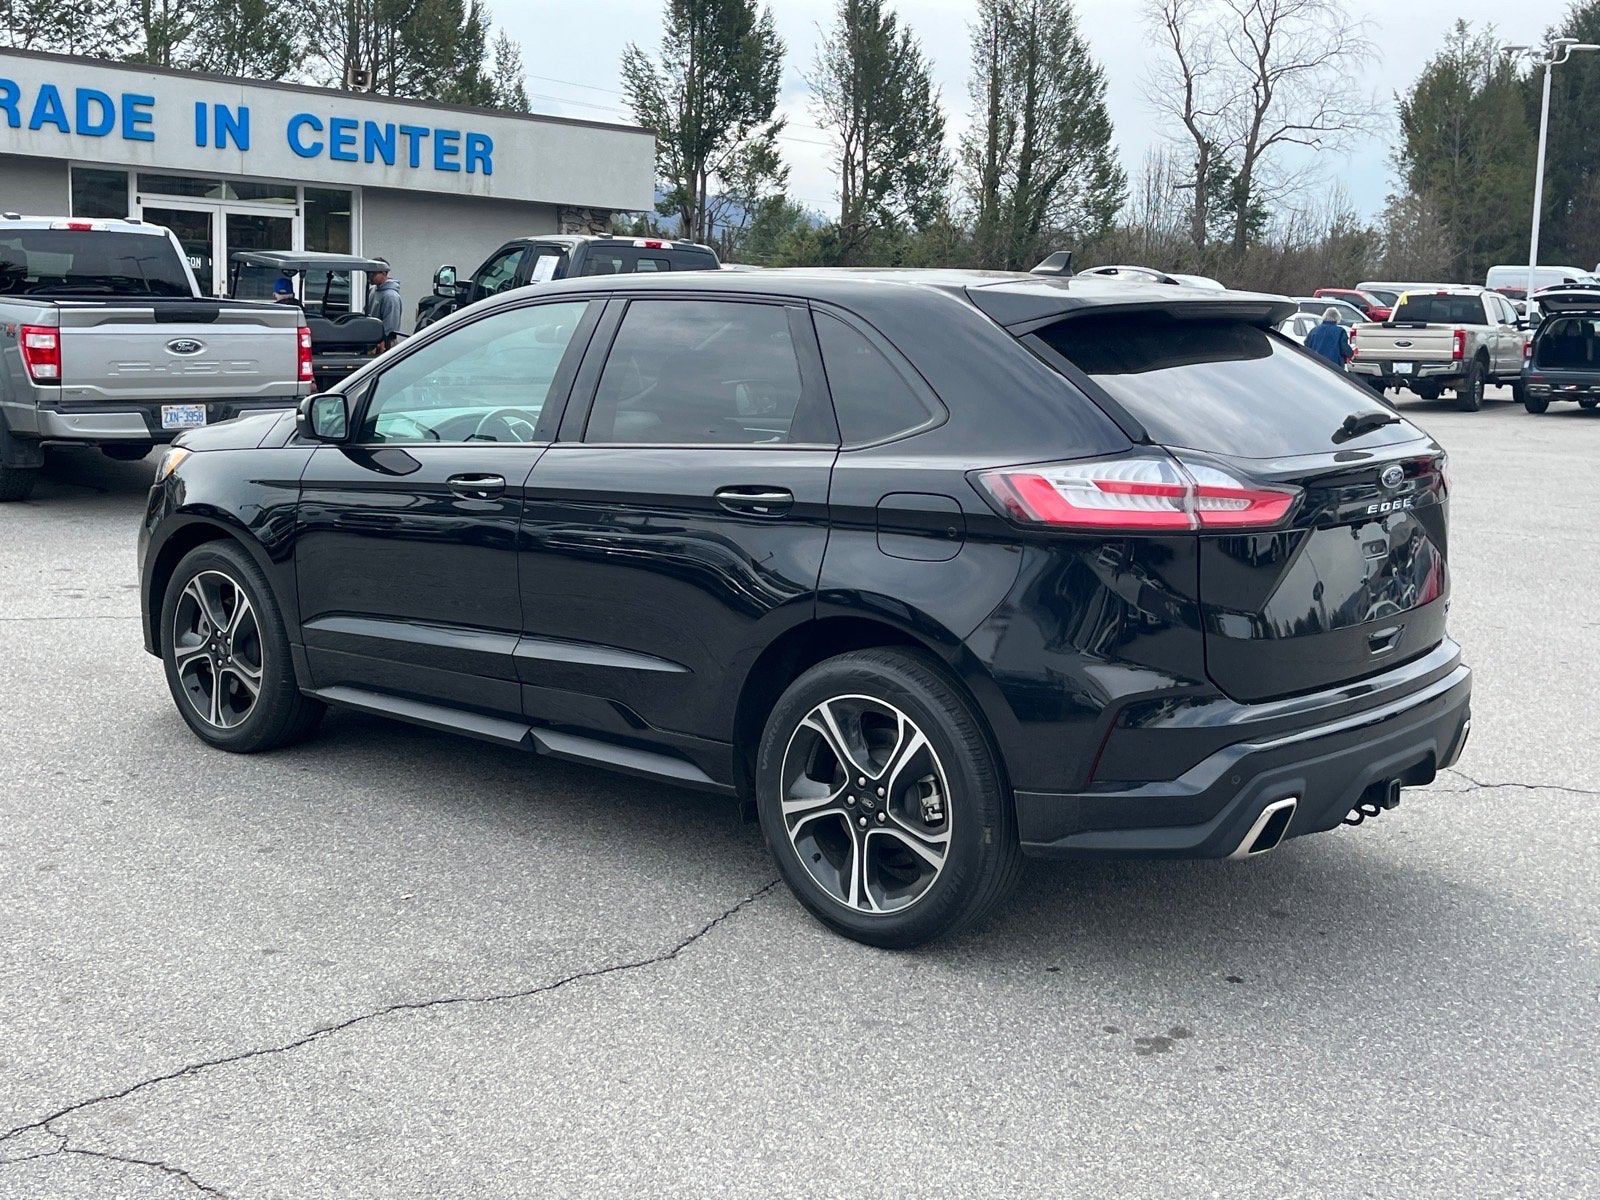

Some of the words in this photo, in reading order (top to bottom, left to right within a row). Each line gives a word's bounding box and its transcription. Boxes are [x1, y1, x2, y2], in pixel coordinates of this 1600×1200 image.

[195, 102, 249, 151] IN
[287, 113, 494, 175] CENTER
[176, 341, 196, 351] Ford
[1367, 496, 1413, 514] EDGE
